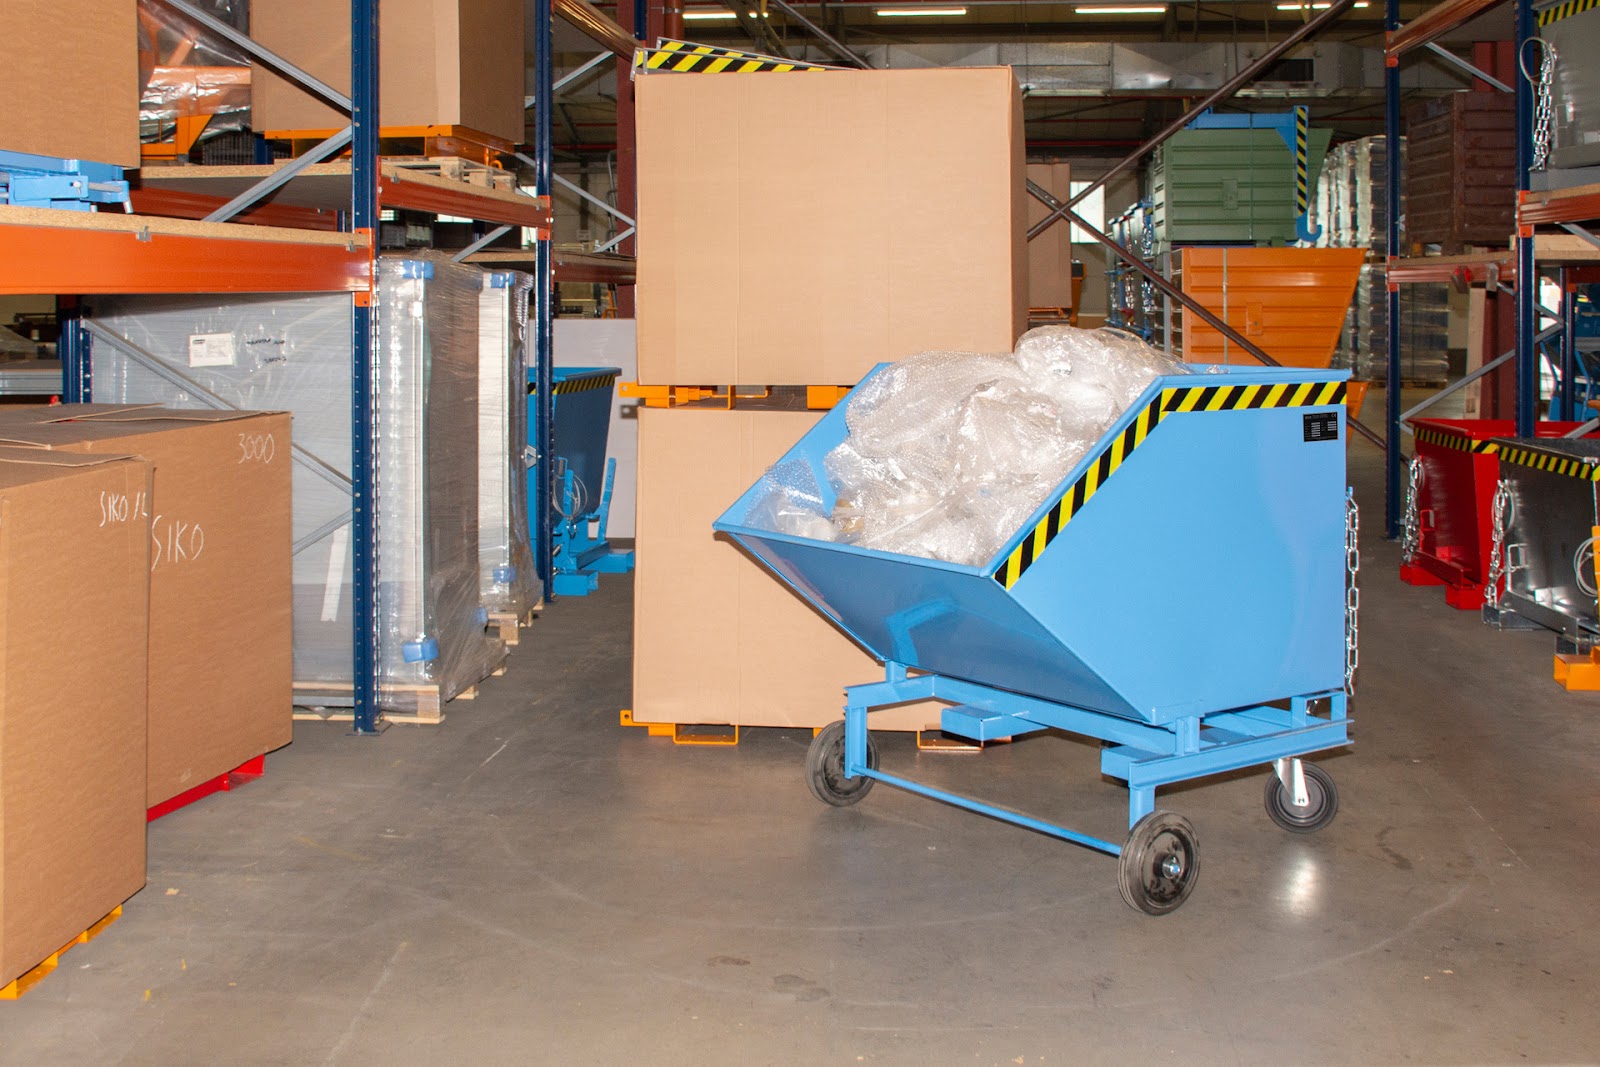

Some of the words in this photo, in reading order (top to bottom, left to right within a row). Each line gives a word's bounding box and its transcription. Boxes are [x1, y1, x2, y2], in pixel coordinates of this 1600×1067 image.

[238, 433, 275, 464] 3000
[99, 491, 128, 527] SIKO
[151, 514, 204, 572] SIKO
